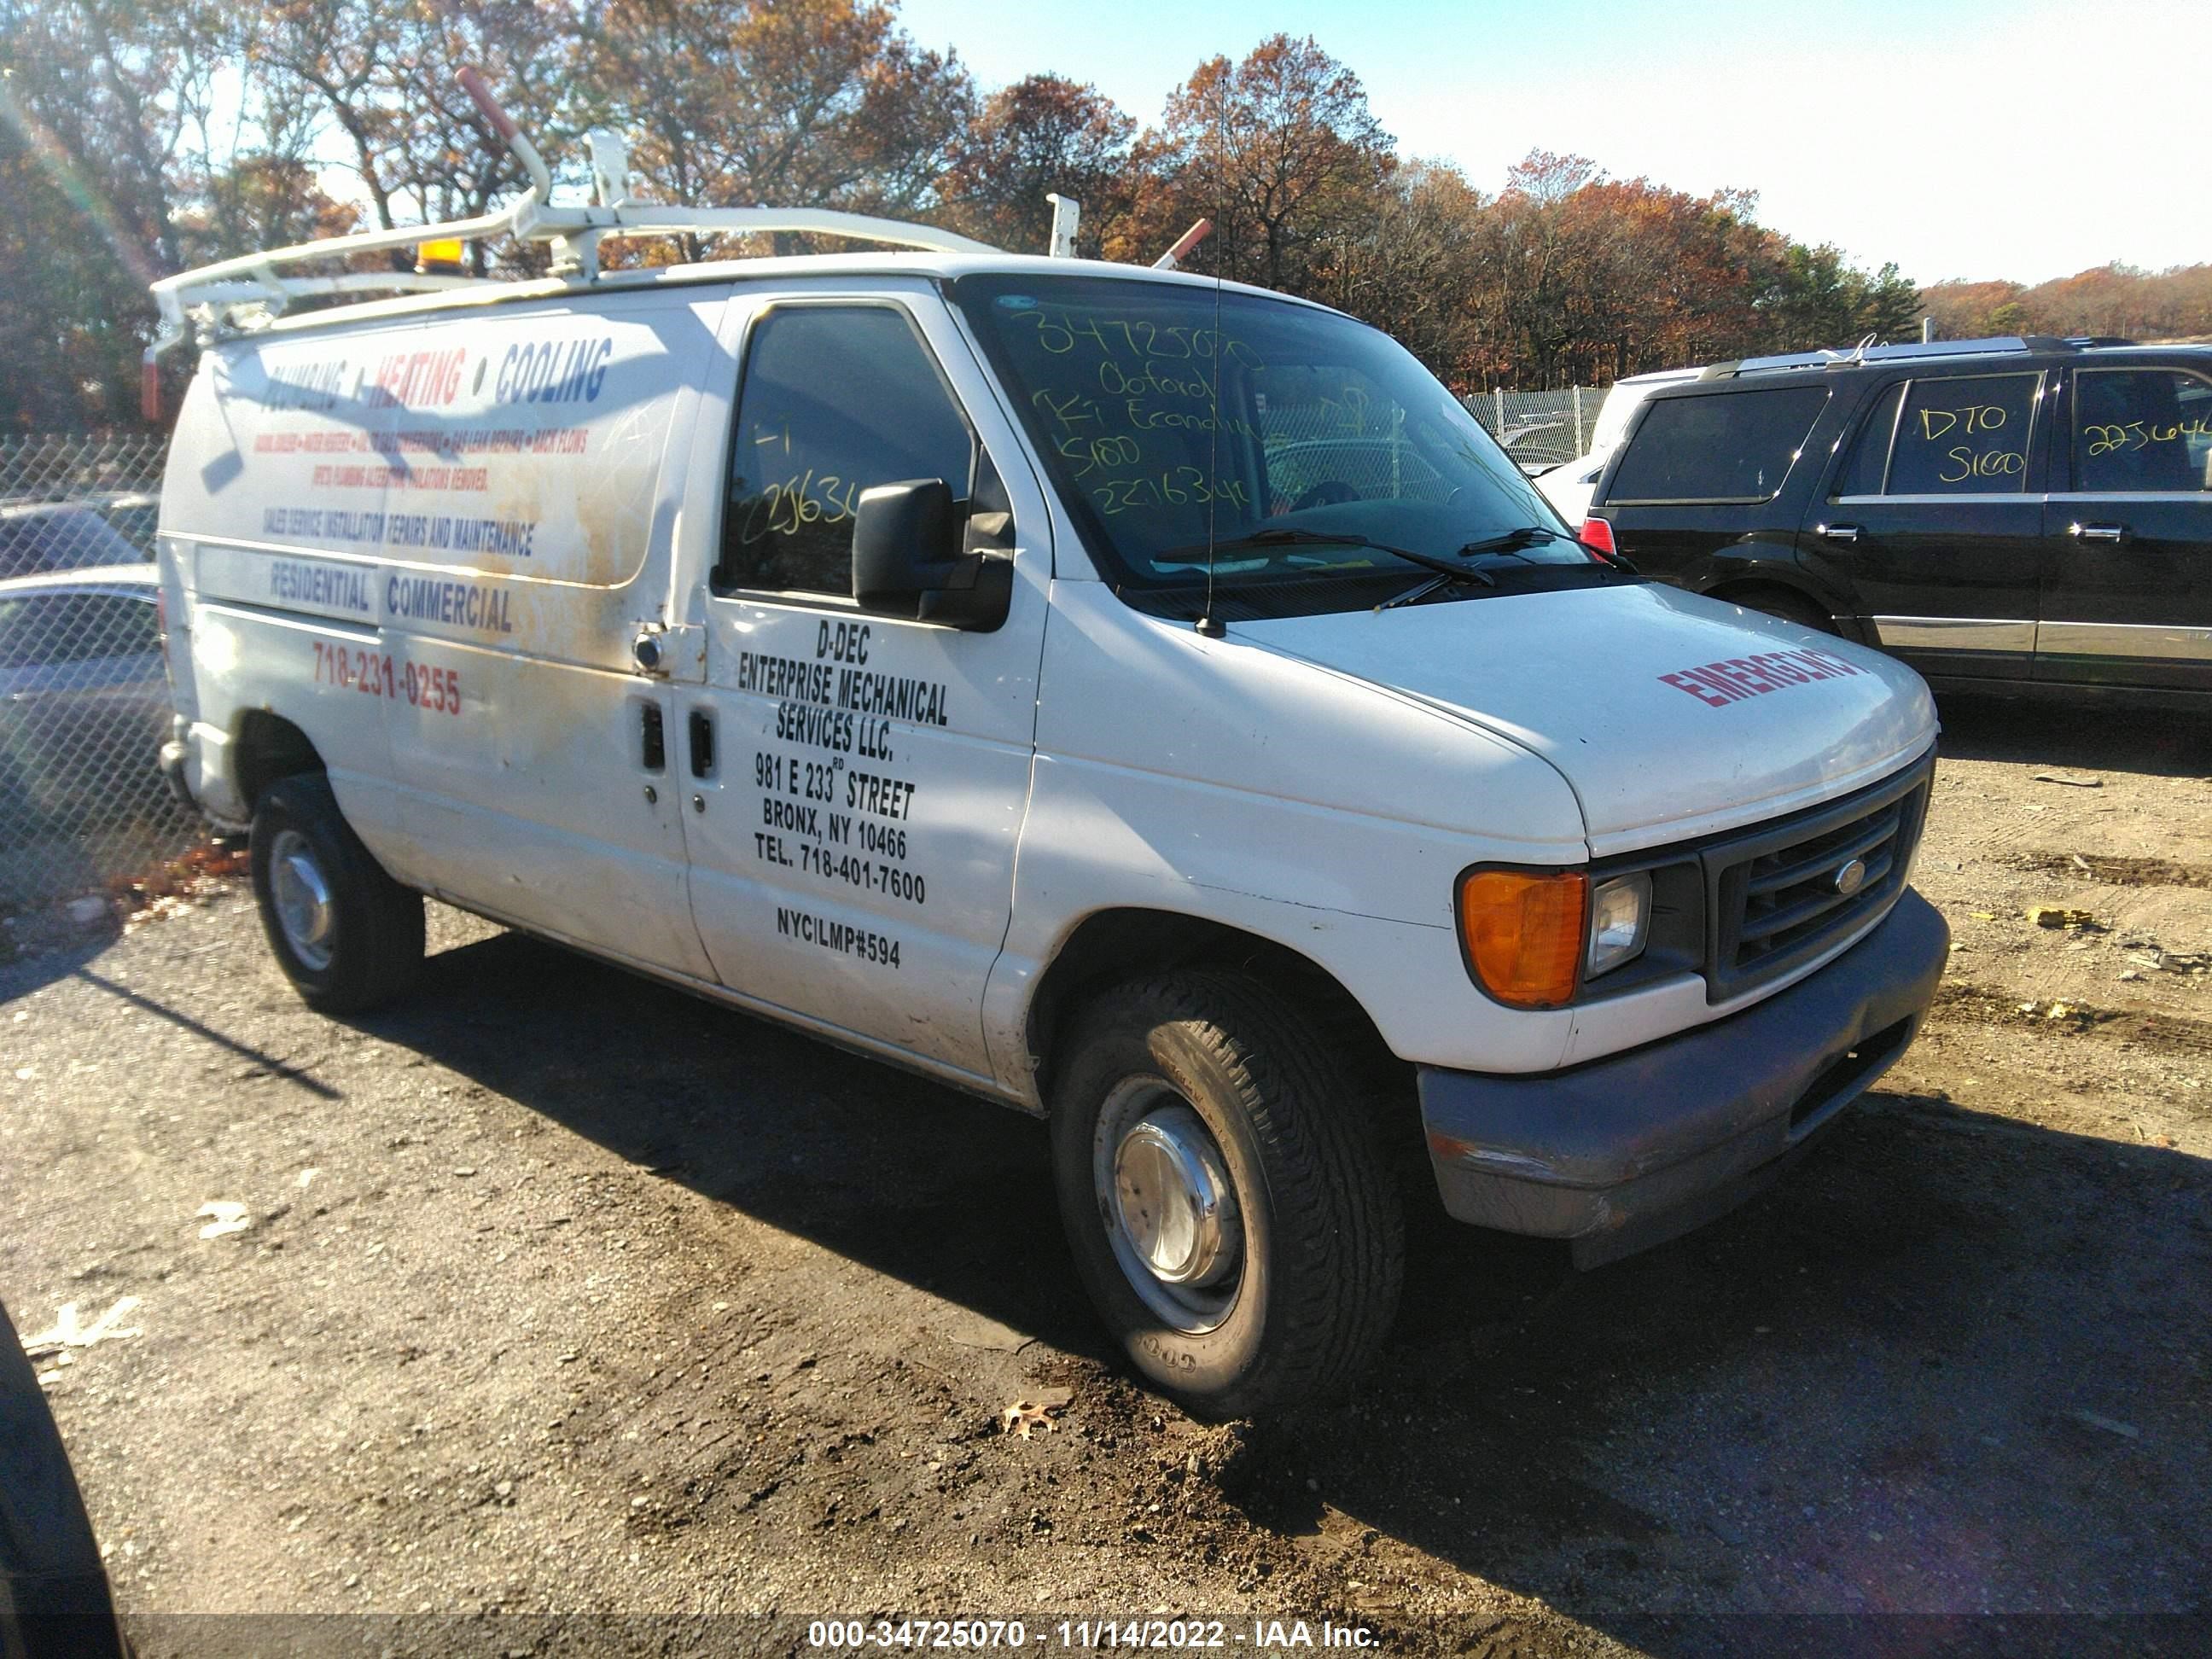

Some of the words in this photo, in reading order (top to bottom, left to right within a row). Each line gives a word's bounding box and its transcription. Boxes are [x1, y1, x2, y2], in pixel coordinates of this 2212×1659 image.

[369, 347, 466, 410] HEATING
[495, 338, 612, 405] COOLING
[1920, 405, 2007, 440] DTO
[323, 510, 383, 544] INSTALLATION
[387, 514, 427, 547] REPAIRS
[428, 516, 451, 549] AND
[452, 518, 536, 557] MAINTENANCE
[271, 561, 369, 611] RESIDENTIAL
[387, 576, 512, 633] COMMERCIAL
[817, 620, 870, 666] D-DEC
[313, 642, 462, 716] 718-231-0255
[738, 652, 833, 704] ENTERPRISE
[837, 669, 948, 725] MECHANICAL
[1657, 648, 1871, 707] EMERGENCY
[777, 701, 853, 753] SERVICES
[859, 717, 893, 761] LLC.
[755, 752, 781, 791] 981
[789, 759, 799, 795] E
[847, 770, 916, 821] STREET
[764, 798, 822, 845] BRONX,
[830, 813, 851, 845] NY
[859, 820, 906, 860] 10466
[754, 832, 794, 867] TEL.
[800, 844, 925, 904] 718-401-7600
